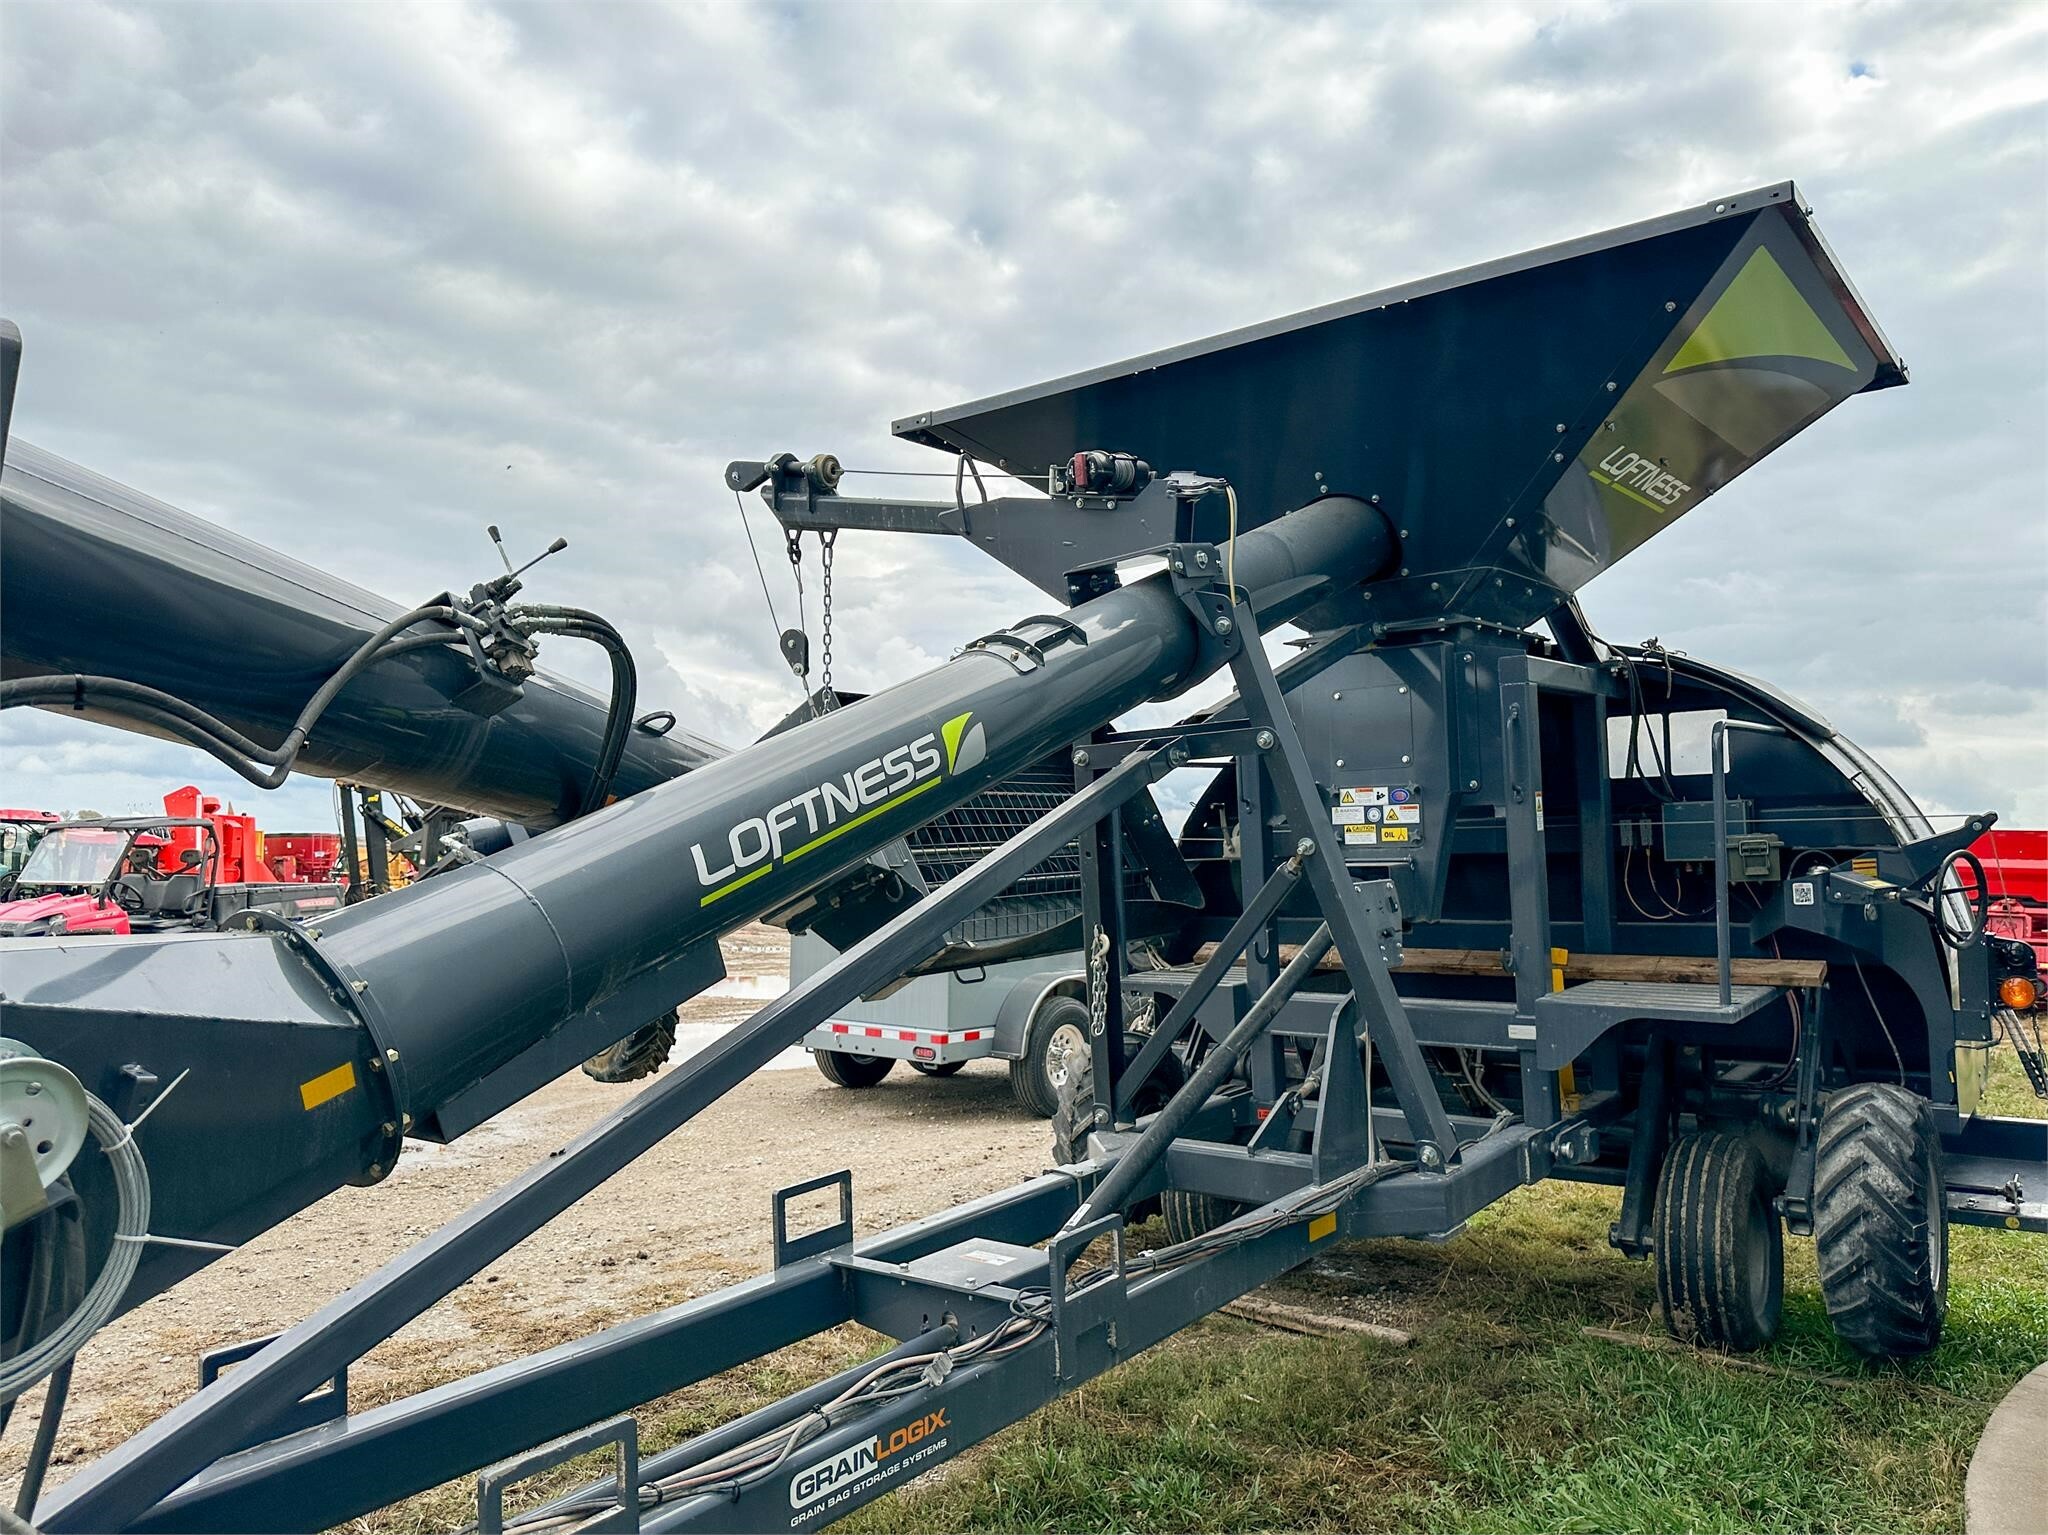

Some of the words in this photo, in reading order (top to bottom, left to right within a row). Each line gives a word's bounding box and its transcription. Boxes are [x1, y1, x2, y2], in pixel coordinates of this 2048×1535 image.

[1599, 445, 1692, 505] LOFTNESS
[690, 732, 941, 886] LOFTNESS
[790, 1503, 826, 1528] GRAIN
[828, 1490, 851, 1508] BAG
[853, 1462, 901, 1495] STORAGE
[902, 1438, 948, 1469] SYSTEMS
